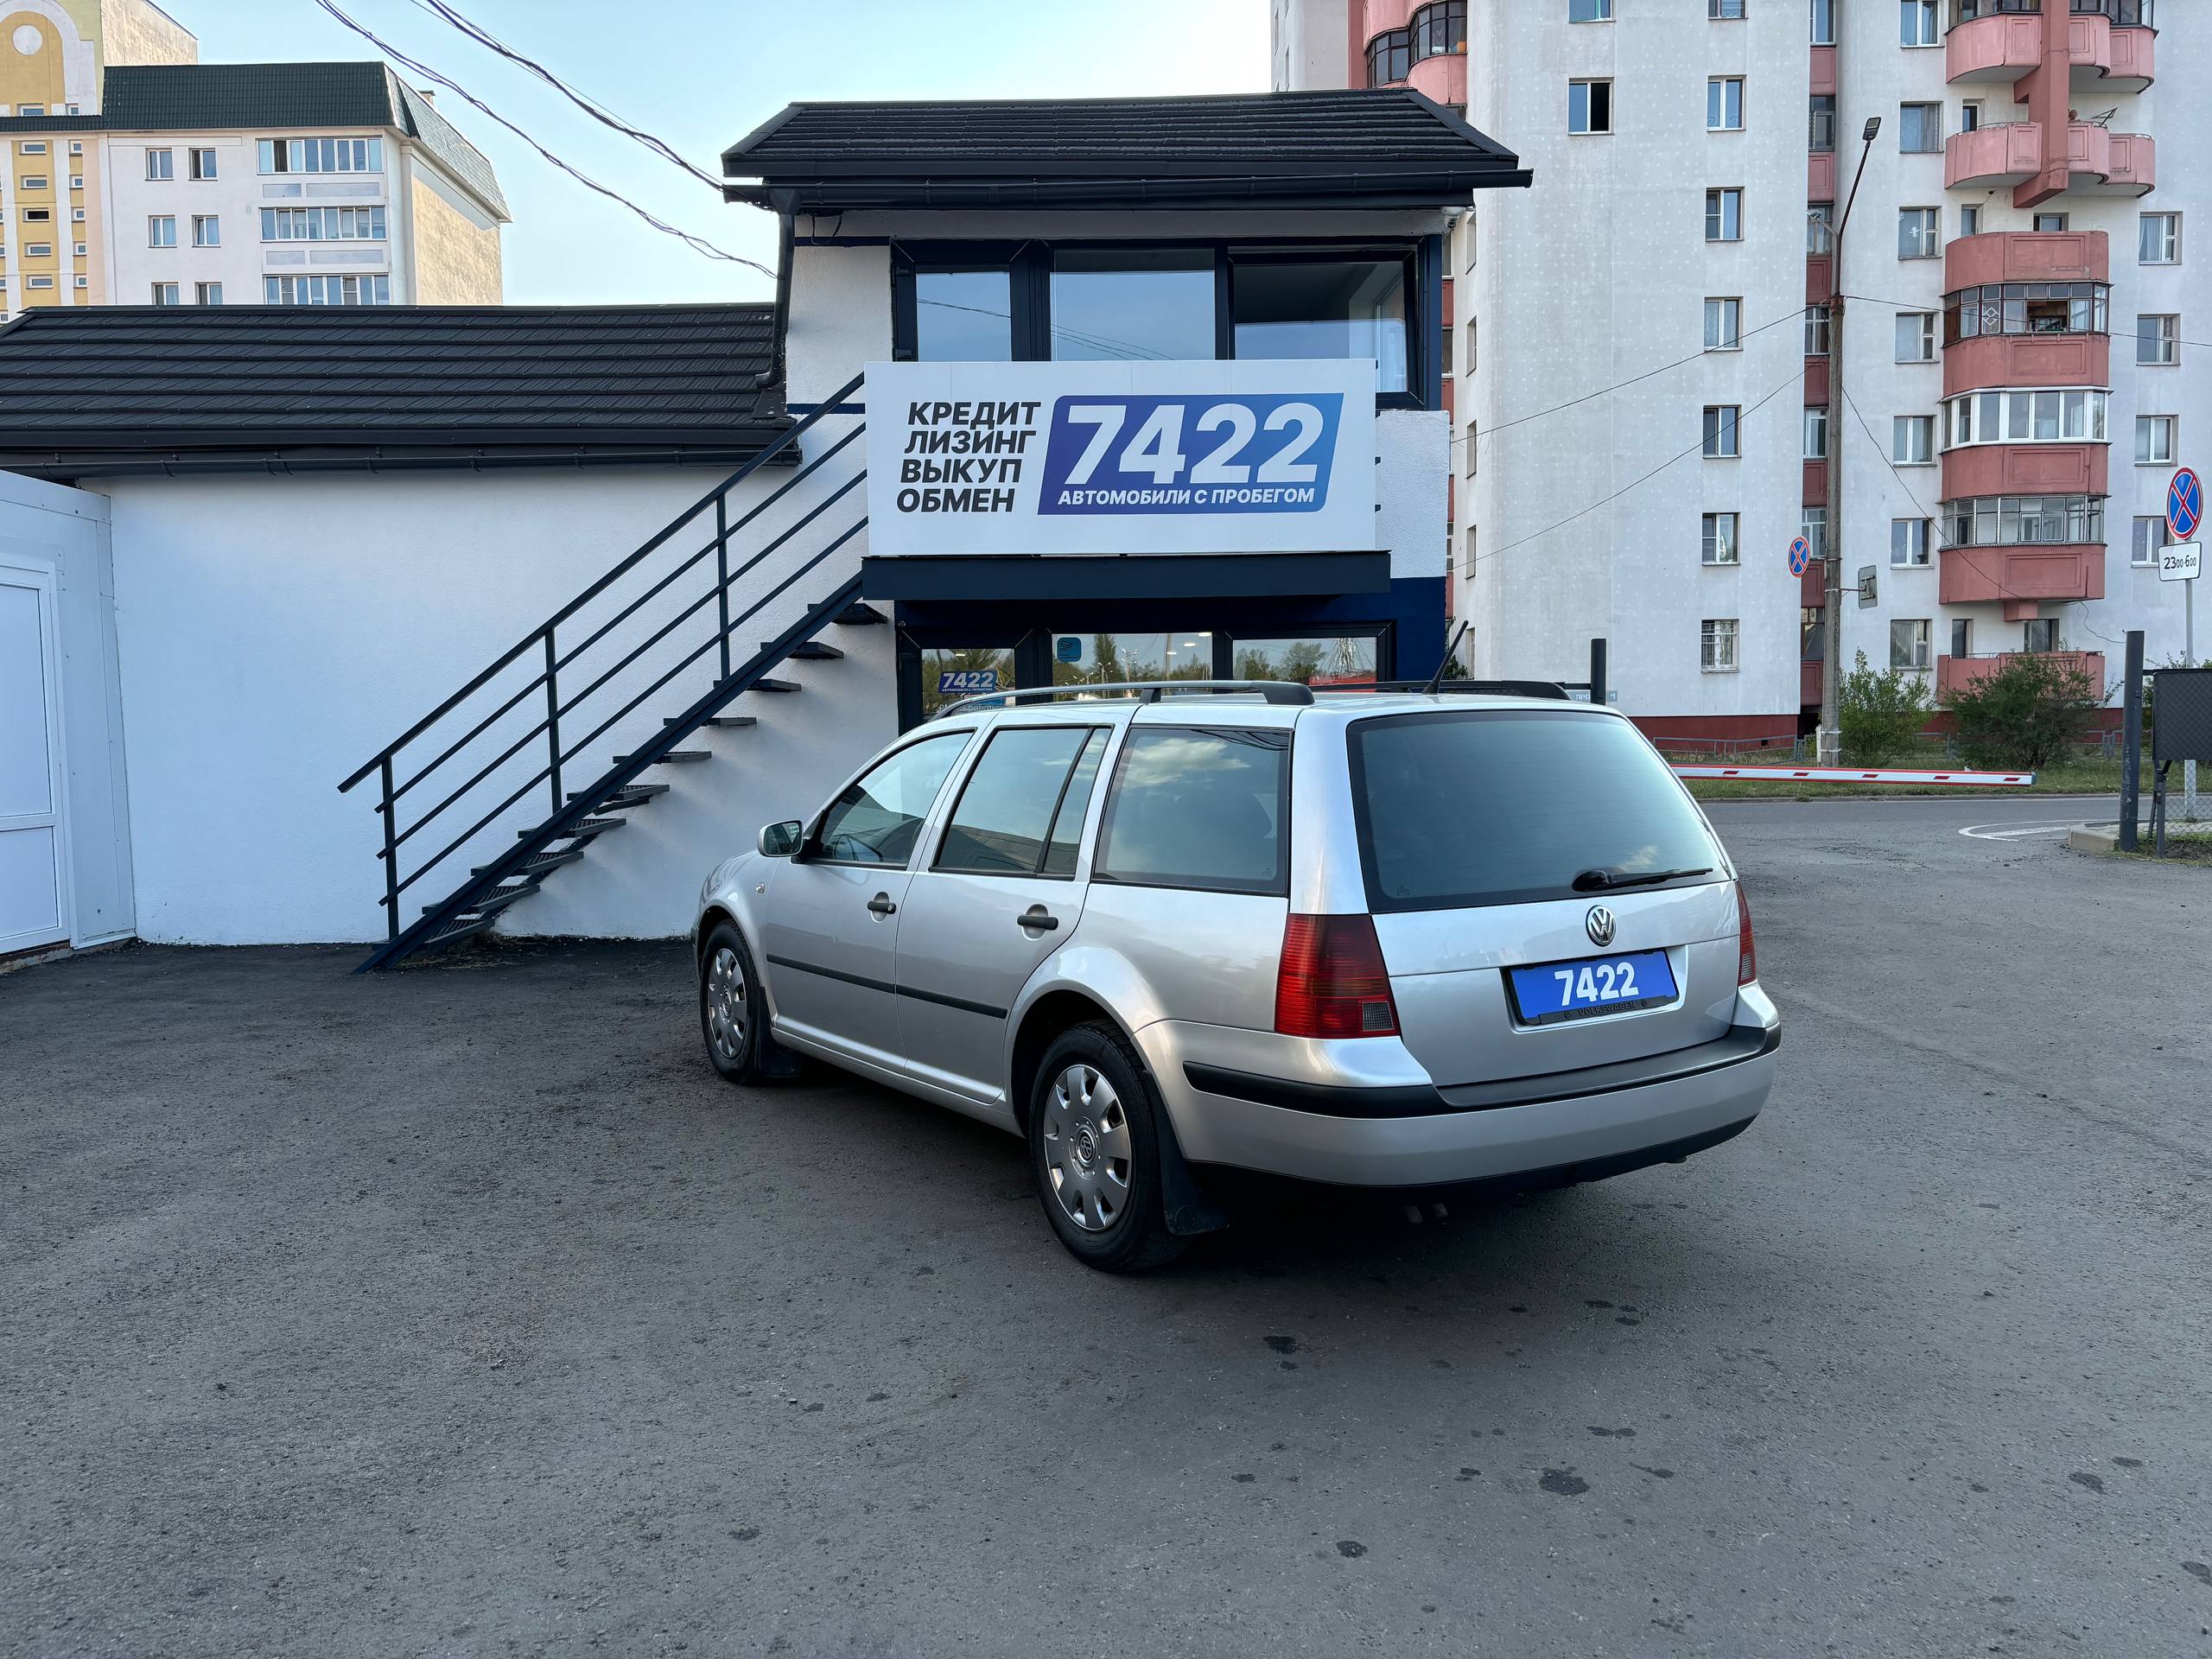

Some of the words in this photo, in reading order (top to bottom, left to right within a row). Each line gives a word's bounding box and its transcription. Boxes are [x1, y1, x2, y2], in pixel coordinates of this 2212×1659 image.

[907, 402, 1041, 429] КРЕДИТ
[904, 430, 1036, 454] ЛИЗИНГ
[1065, 403, 1324, 485] 7422
[900, 459, 1022, 483] ВЫКУП
[897, 488, 1015, 512] ОБМЕН
[1058, 490, 1190, 505] АВТОМОБИЛИ
[1194, 489, 1207, 504] С
[1211, 487, 1315, 504] ПРОБЕГОМ
[943, 672, 994, 689] 7422
[1554, 962, 1639, 1007] 7422
[1579, 1001, 1636, 1017] VOLKSWAGEN
